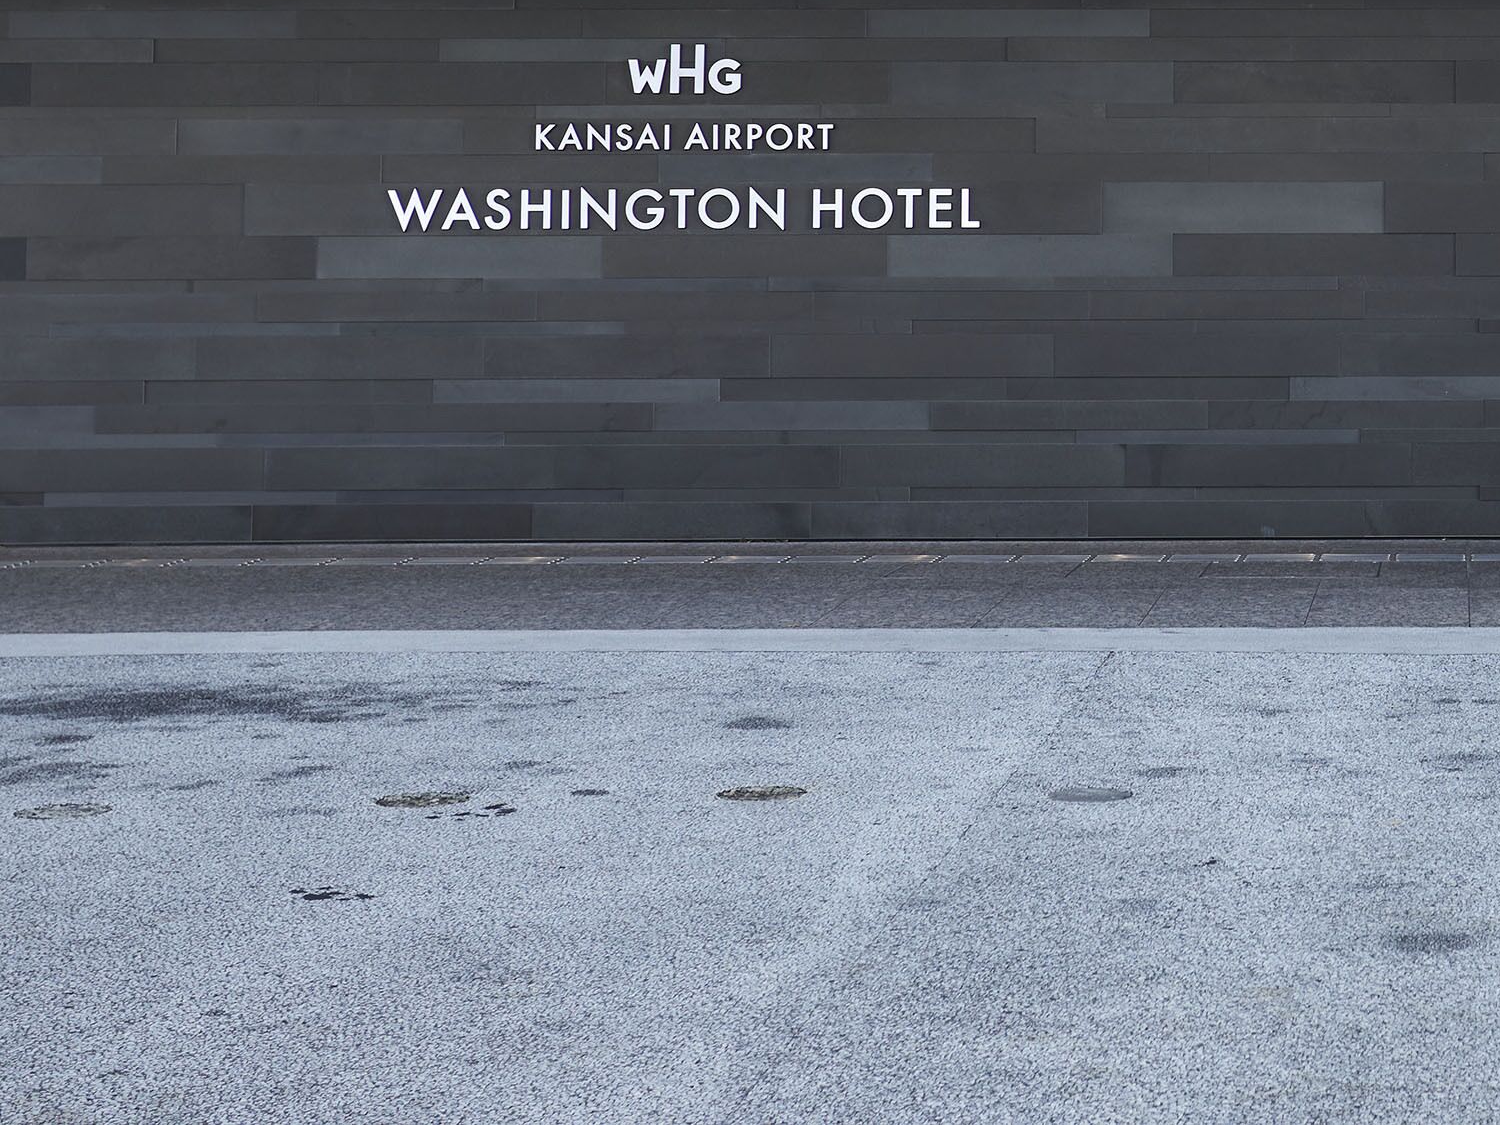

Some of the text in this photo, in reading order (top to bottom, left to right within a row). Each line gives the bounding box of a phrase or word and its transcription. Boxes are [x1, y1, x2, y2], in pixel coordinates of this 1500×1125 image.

[535, 122, 834, 152] KANSAI AIRPORT
[387, 186, 980, 232] WASHINGTON HOTEL
